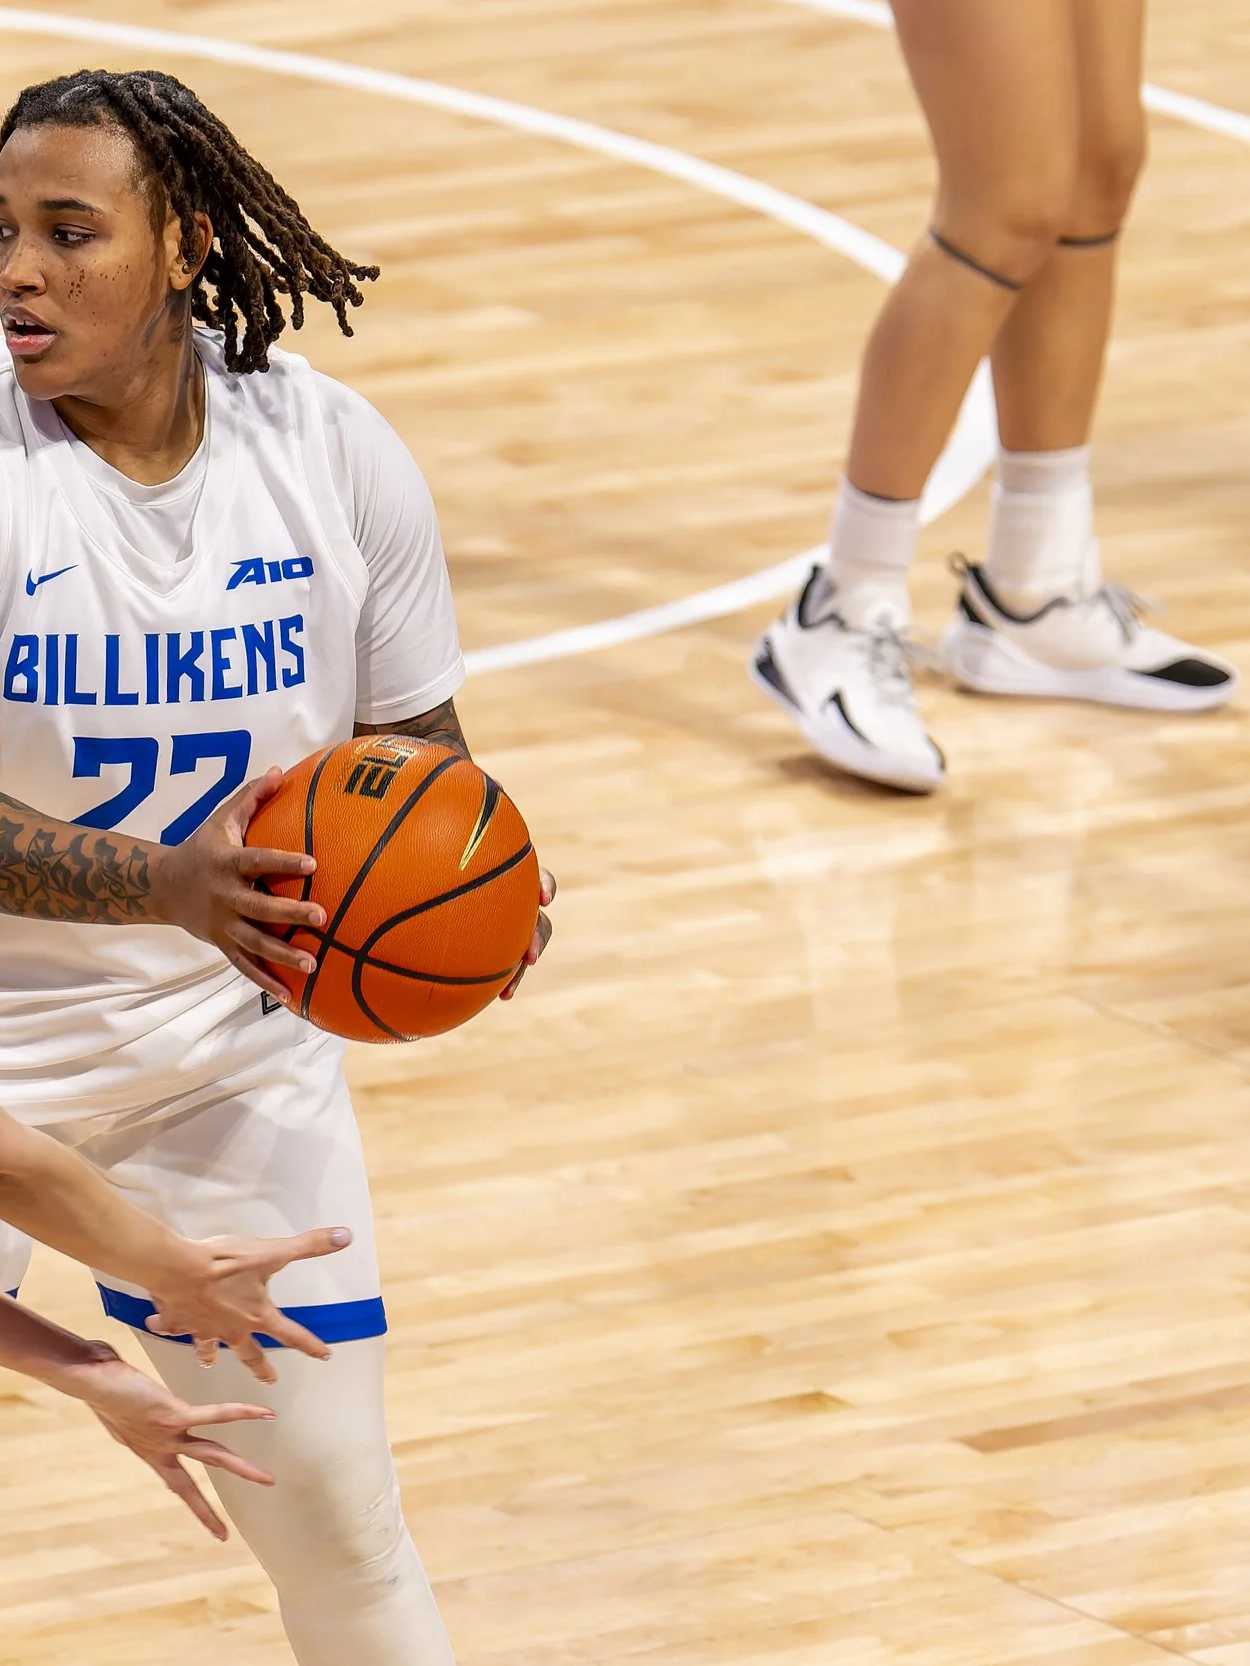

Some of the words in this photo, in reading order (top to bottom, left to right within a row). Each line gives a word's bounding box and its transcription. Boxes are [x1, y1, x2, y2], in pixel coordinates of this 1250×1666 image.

[225, 556, 315, 591] A10
[3, 613, 306, 706] BILLIKENS
[70, 730, 252, 847] 22
